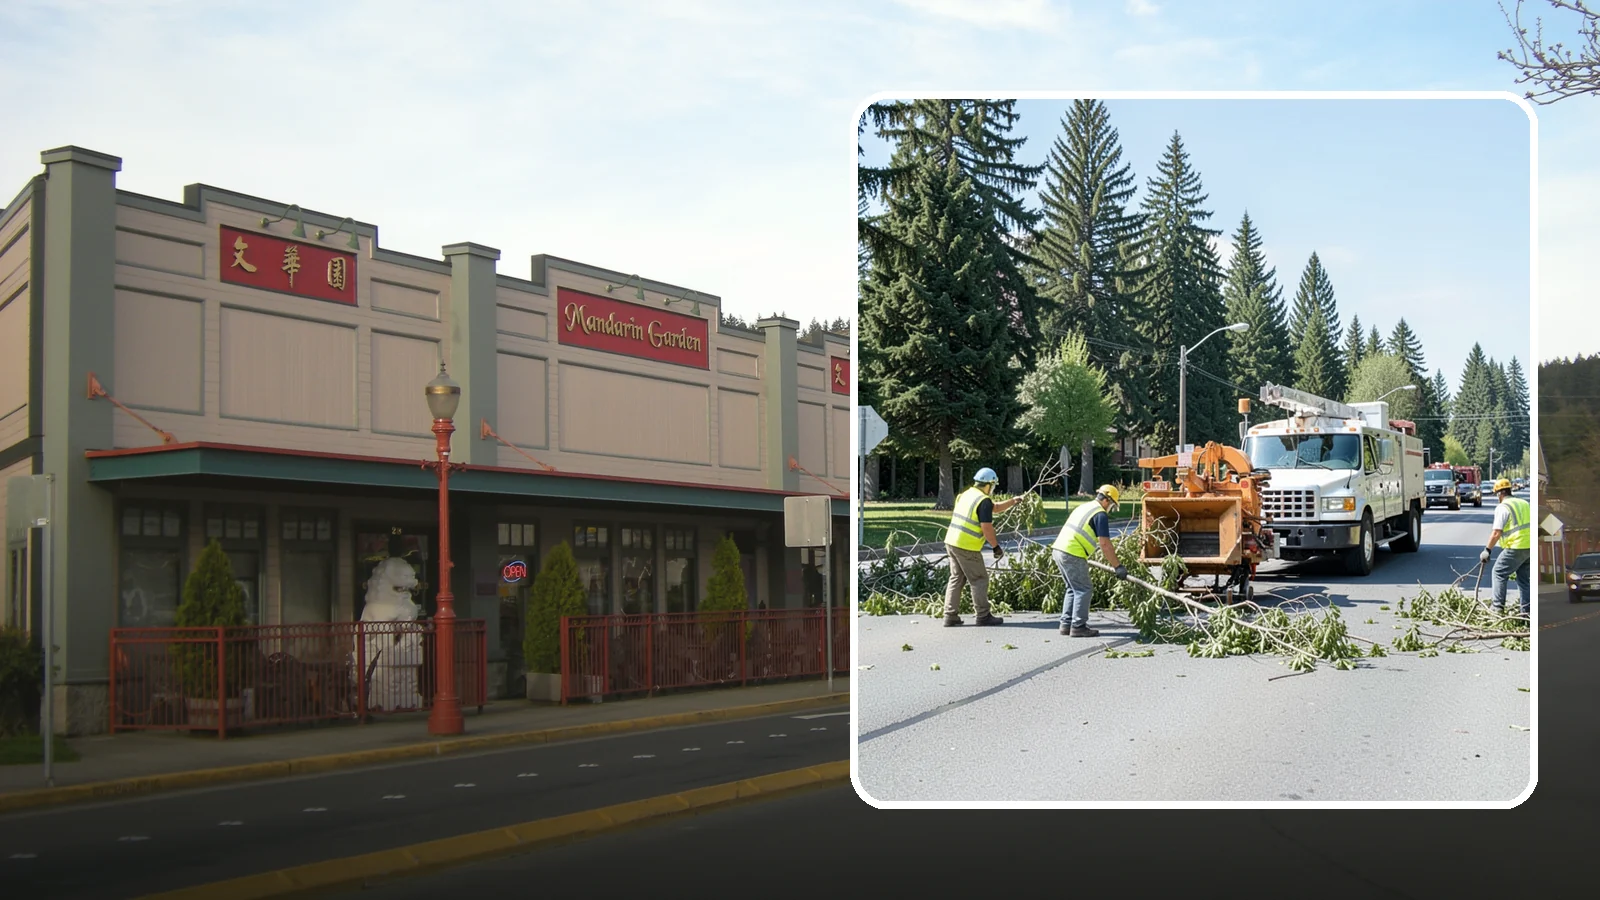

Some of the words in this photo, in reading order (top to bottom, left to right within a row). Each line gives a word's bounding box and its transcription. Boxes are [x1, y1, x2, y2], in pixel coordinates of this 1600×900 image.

[230, 236, 346, 291] 文華園
[564, 302, 644, 341] Mandarin
[647, 320, 702, 352] Garden
[503, 565, 527, 578] OPEN
